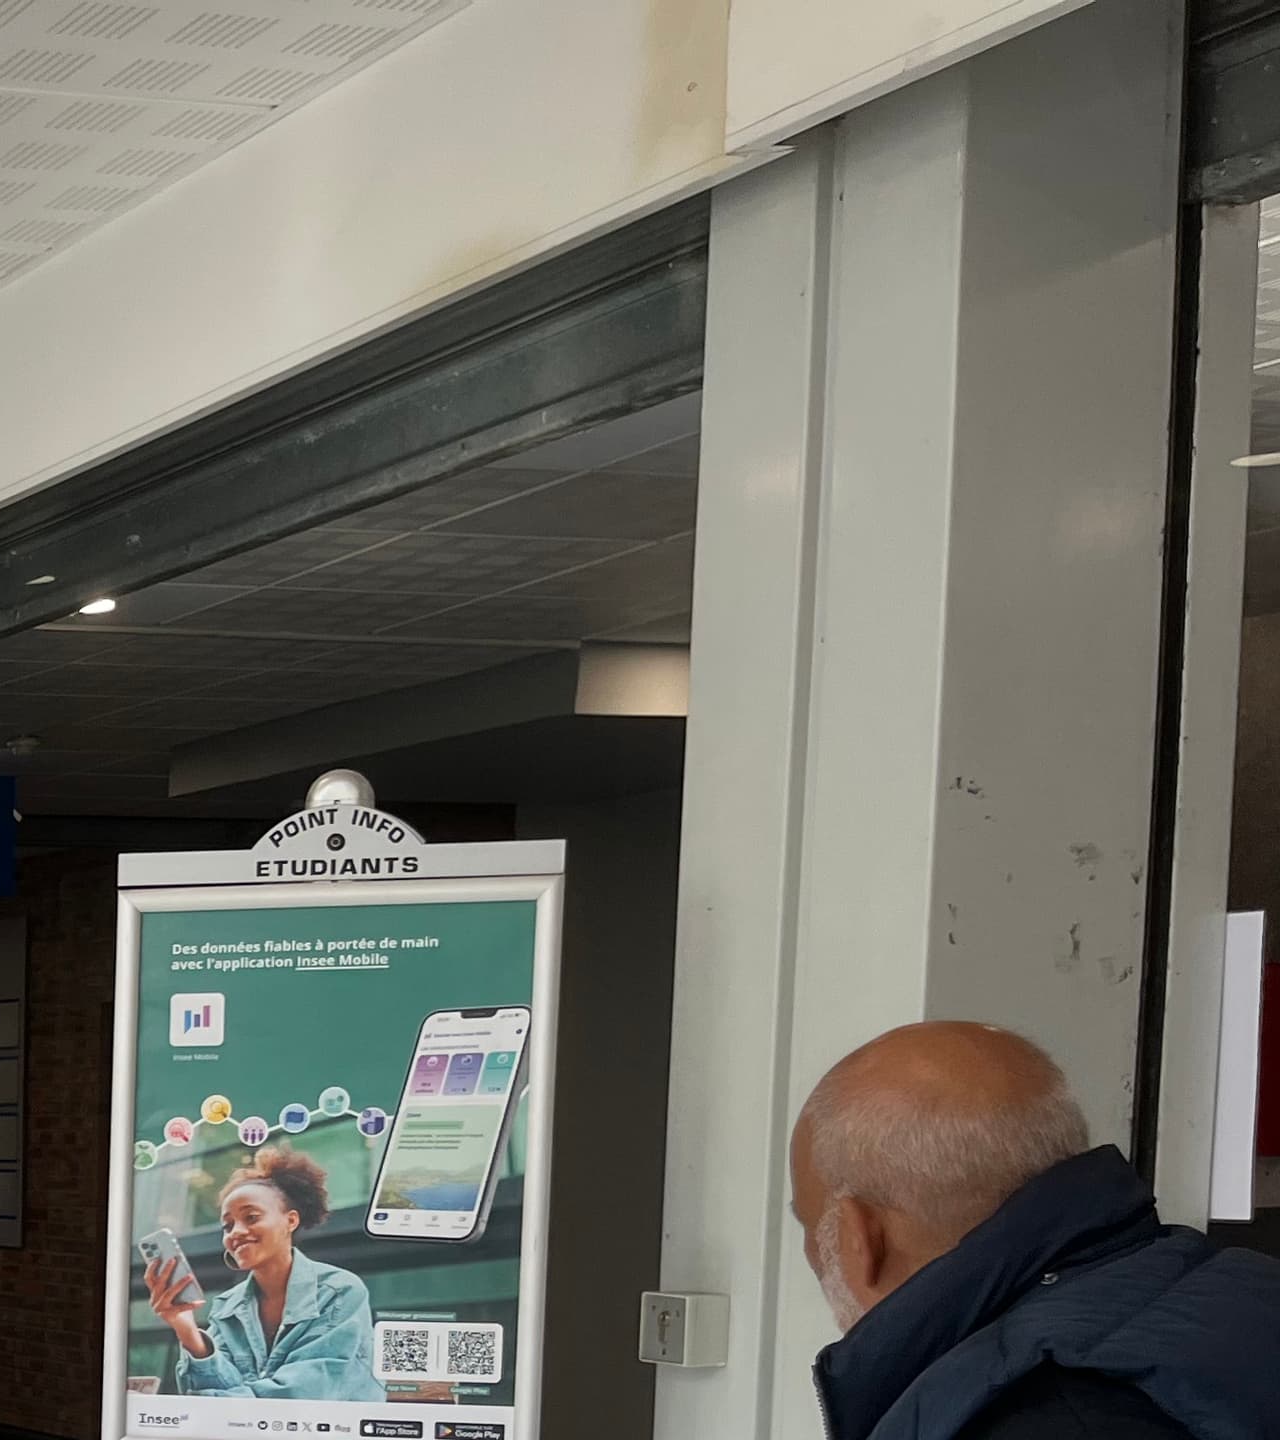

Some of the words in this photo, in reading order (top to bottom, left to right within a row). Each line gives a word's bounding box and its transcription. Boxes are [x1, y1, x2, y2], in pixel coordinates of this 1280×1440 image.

[268, 808, 338, 848] POINT
[351, 809, 406, 844] INFO
[255, 856, 419, 877] ETUDIANTS
[171, 943, 198, 955] Des
[200, 941, 261, 954] données
[264, 939, 312, 953] fiables
[314, 938, 324, 951] à
[327, 938, 376, 953] portée
[379, 936, 398, 949] de
[401, 936, 439, 949] main
[171, 960, 204, 971] avec
[206, 956, 293, 972] l'application
[296, 955, 336, 967] Insee
[339, 952, 389, 966] Mobile
[139, 1412, 180, 1425] Insee
[454, 1428, 484, 1440] Google
[485, 1431, 501, 1440] Play
